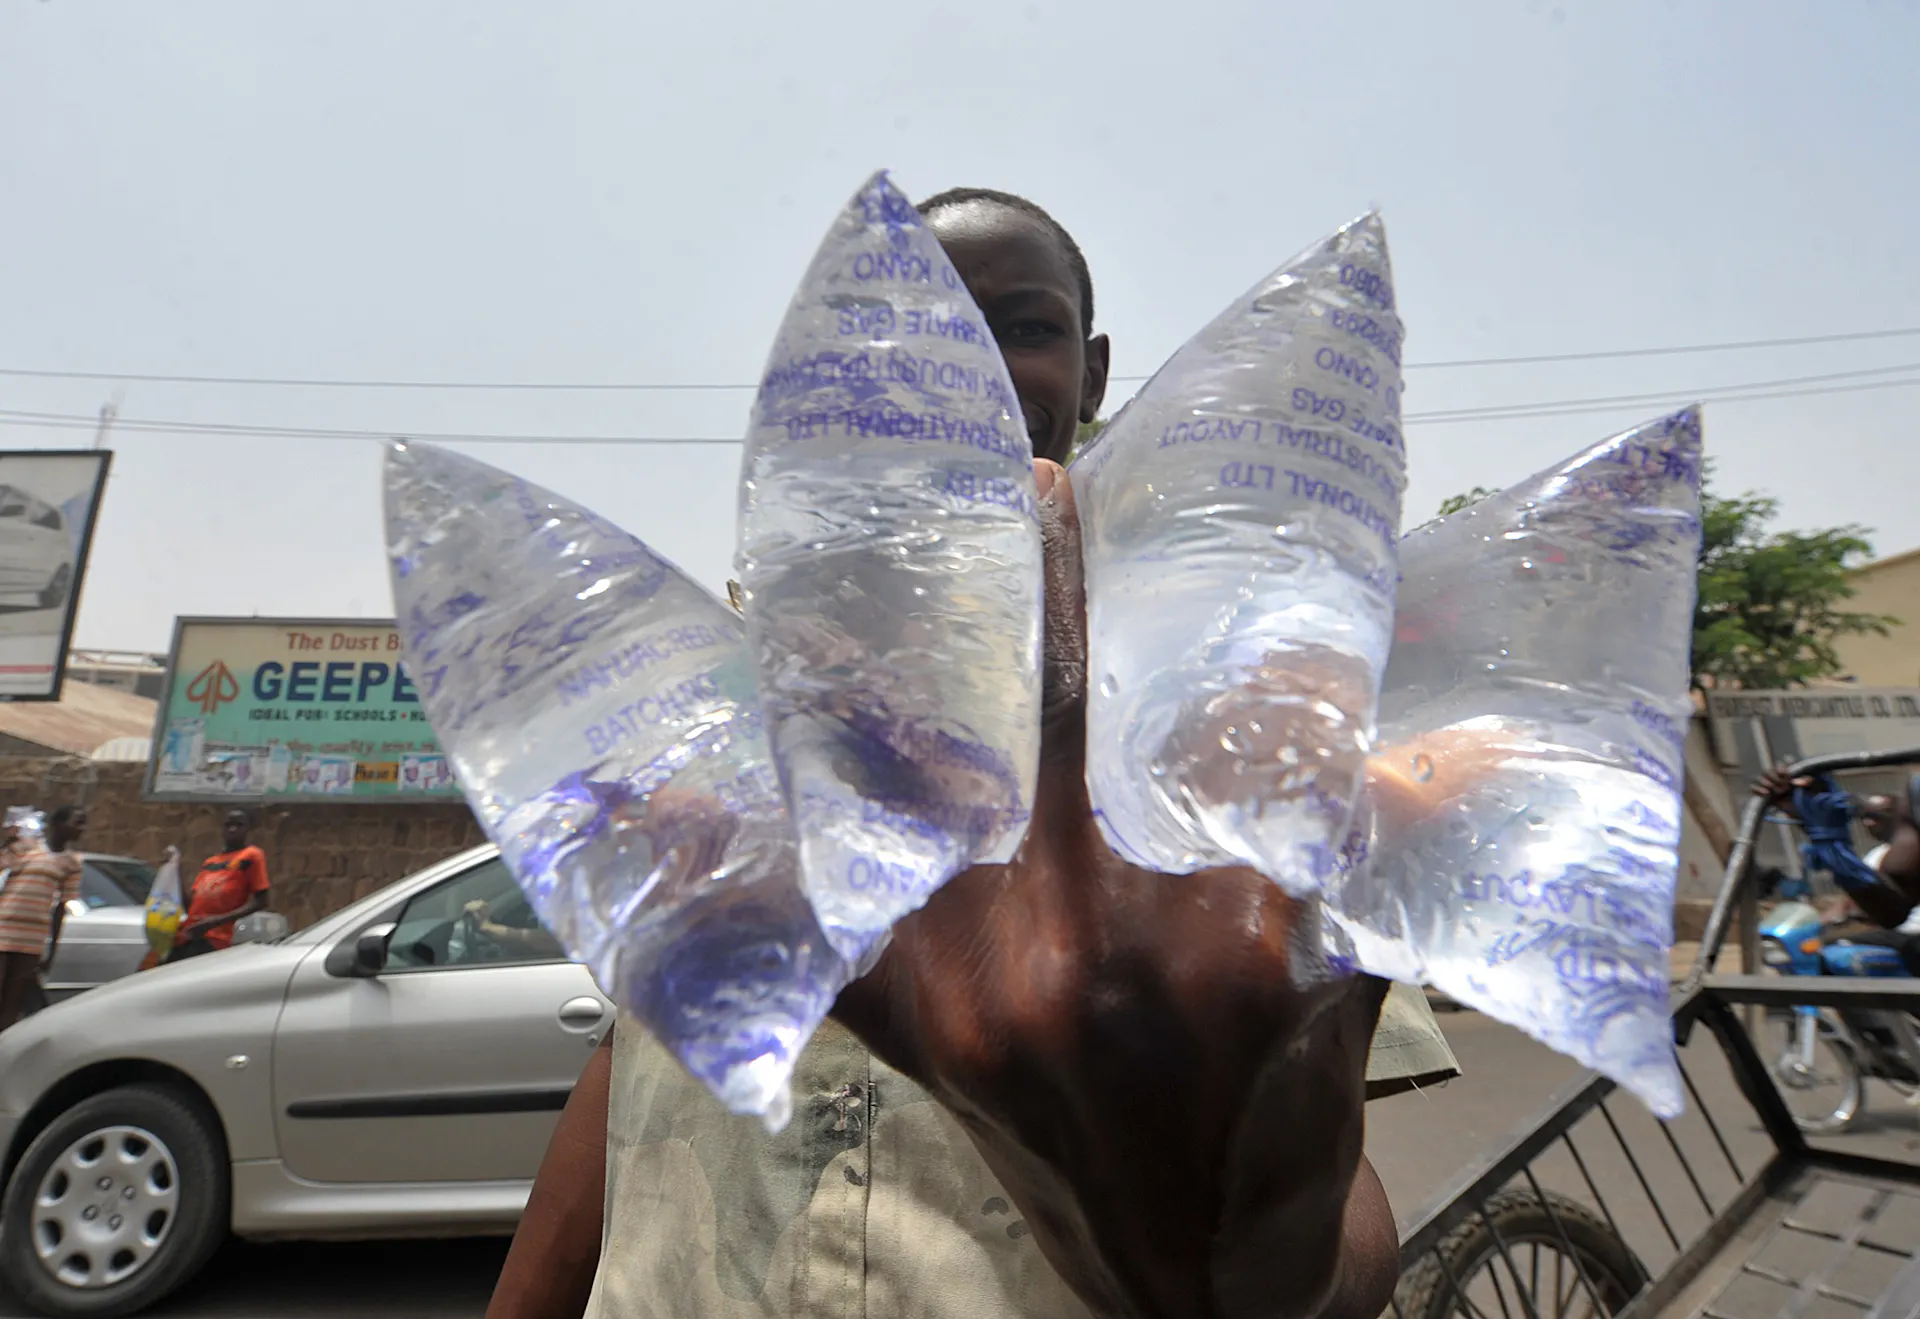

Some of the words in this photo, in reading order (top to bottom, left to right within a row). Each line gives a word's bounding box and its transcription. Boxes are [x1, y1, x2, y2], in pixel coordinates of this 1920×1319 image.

[852, 250, 933, 284] KANO
[1291, 387, 1346, 422] GAS
[1158, 418, 1262, 449] LAYOUT
[1219, 461, 1275, 491] LTD
[287, 632, 324, 651] The
[330, 633, 380, 651] Dust
[253, 661, 419, 702] GEEPE
[249, 709, 291, 721] IDEAL
[334, 709, 398, 721] SCHOOLS
[582, 688, 680, 757] BATCH
